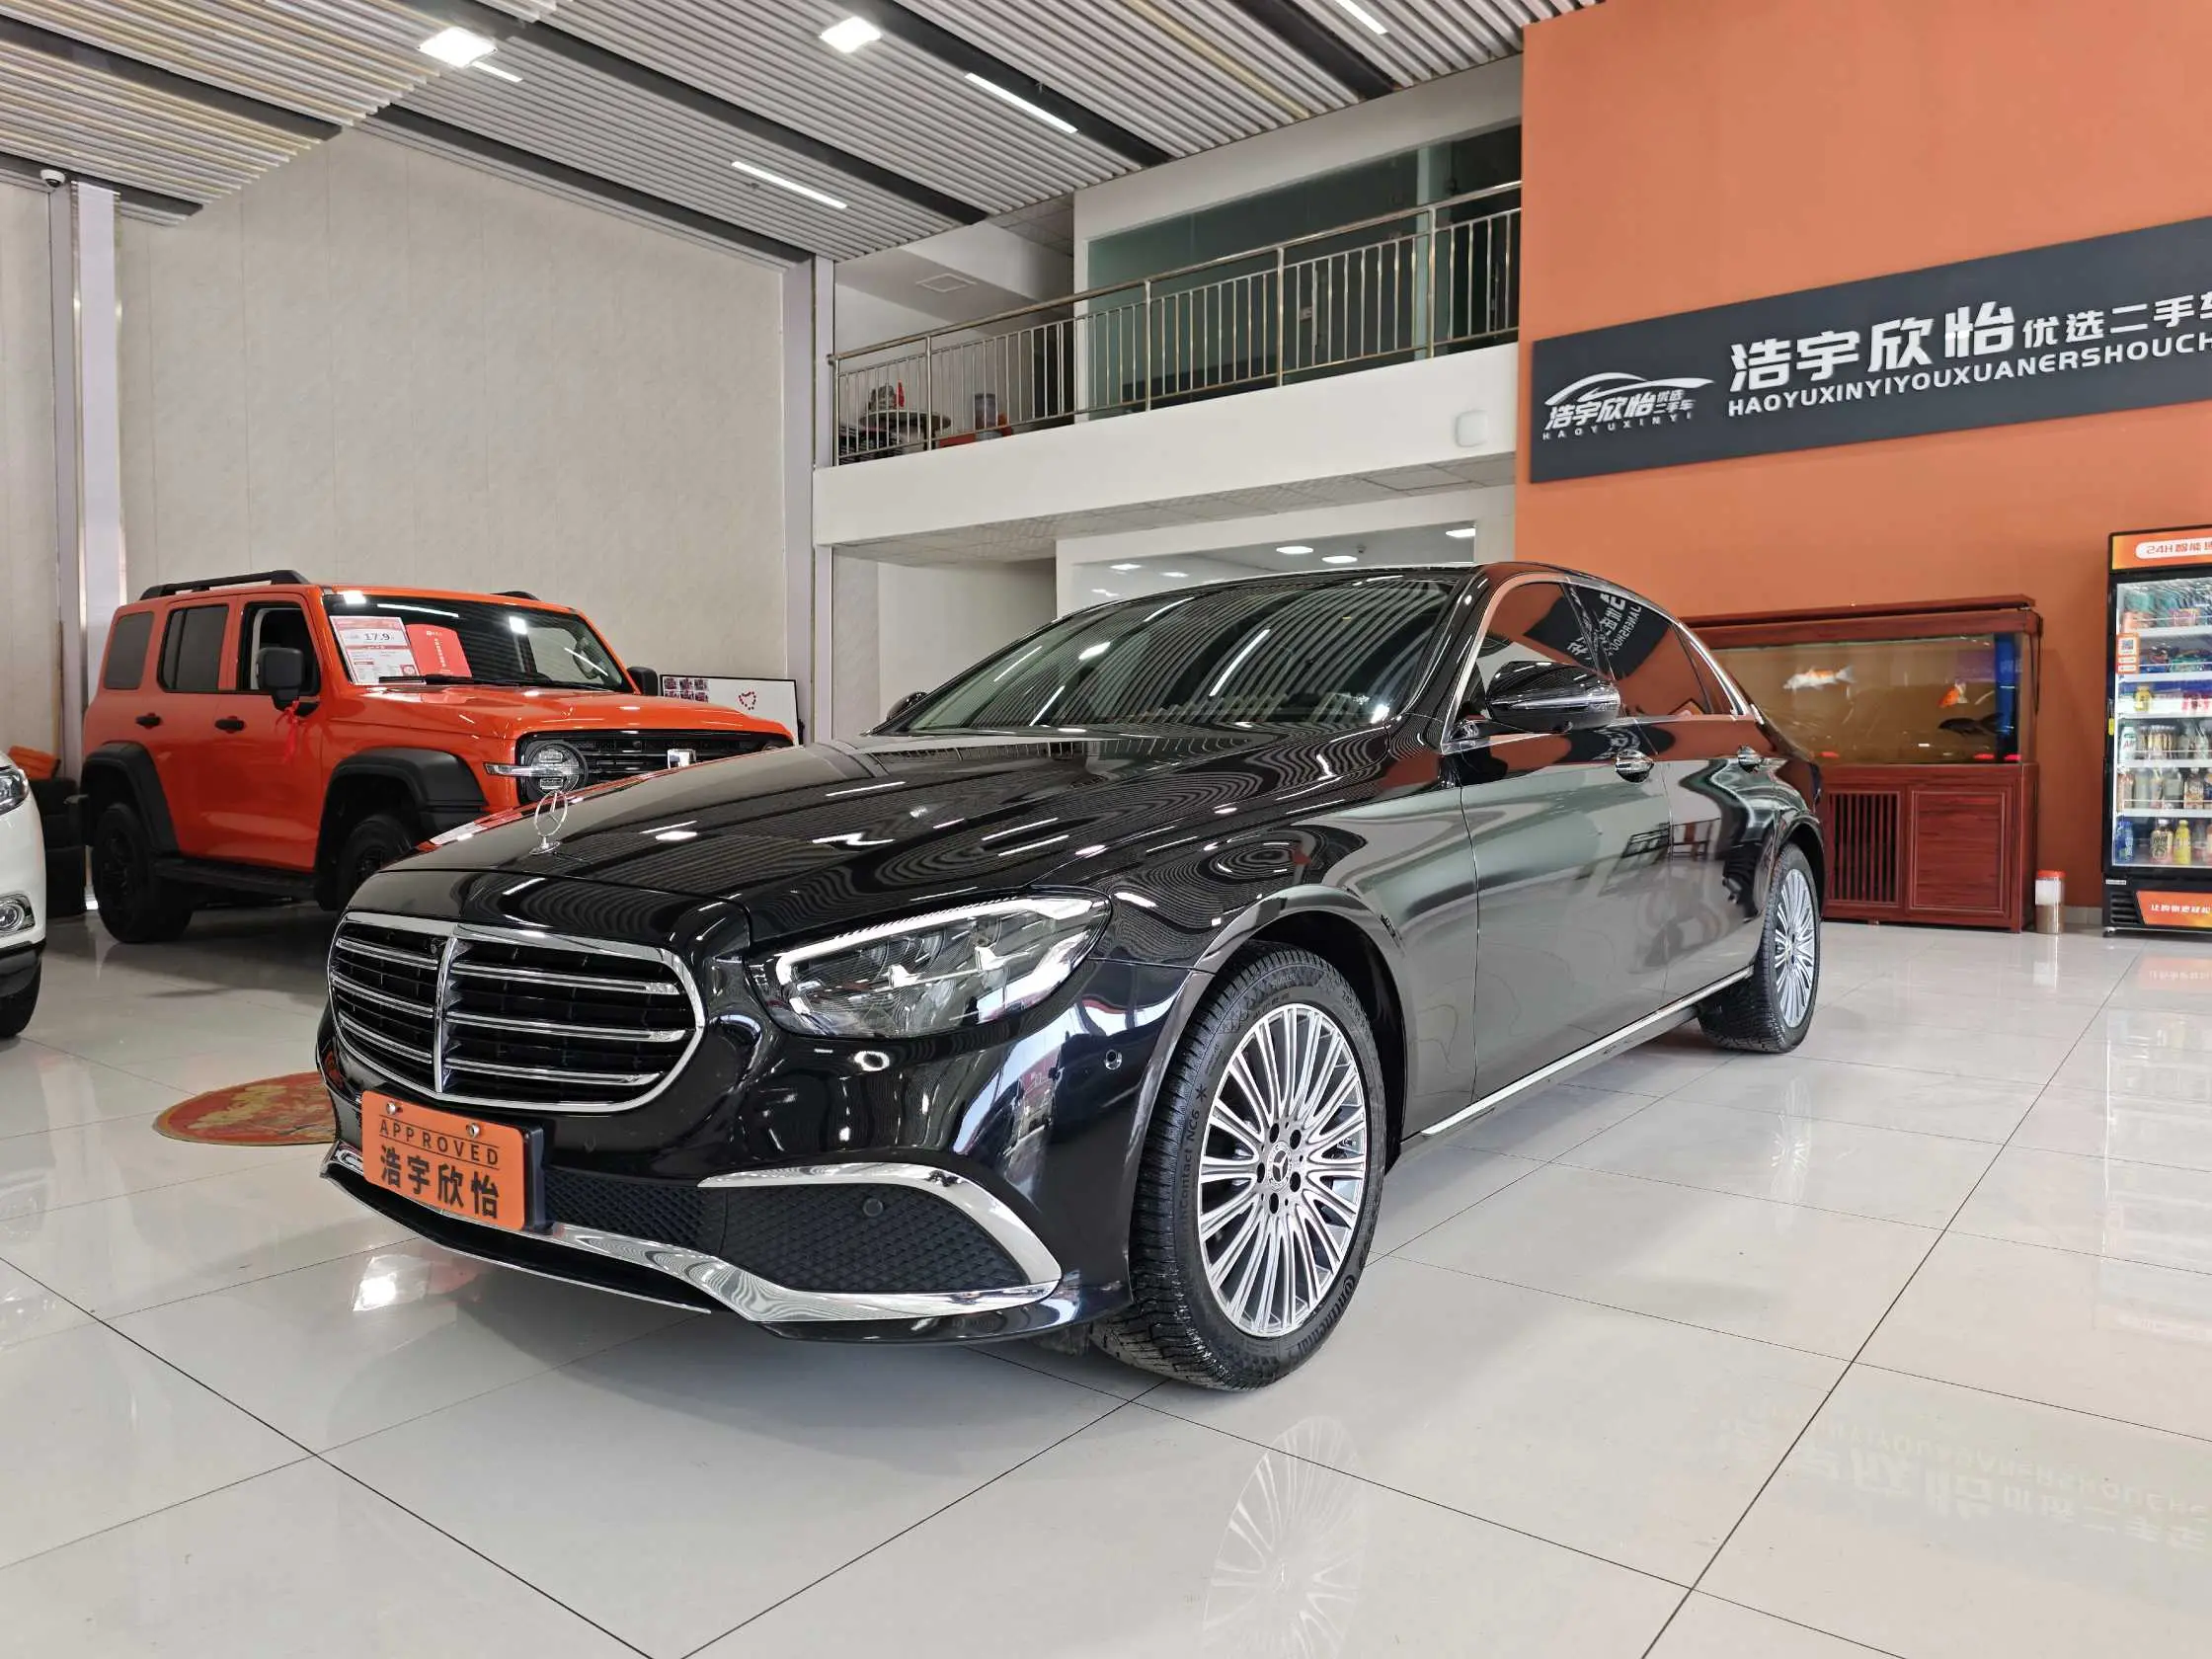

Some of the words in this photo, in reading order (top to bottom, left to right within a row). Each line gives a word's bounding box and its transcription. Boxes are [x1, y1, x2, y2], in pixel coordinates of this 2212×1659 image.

[1730, 291, 2212, 392] 浩宇欣怡优选二手
[1542, 412, 1693, 440] HAOYUXINYI
[1545, 393, 1656, 430] 浩宇欣怡
[1653, 398, 1696, 415] 二手车
[379, 1119, 500, 1166] APPROVED
[1186, 1108, 1200, 1143] NC6
[379, 1144, 500, 1220] 浩宇欣怡
[1297, 1274, 1357, 1354] Continental
